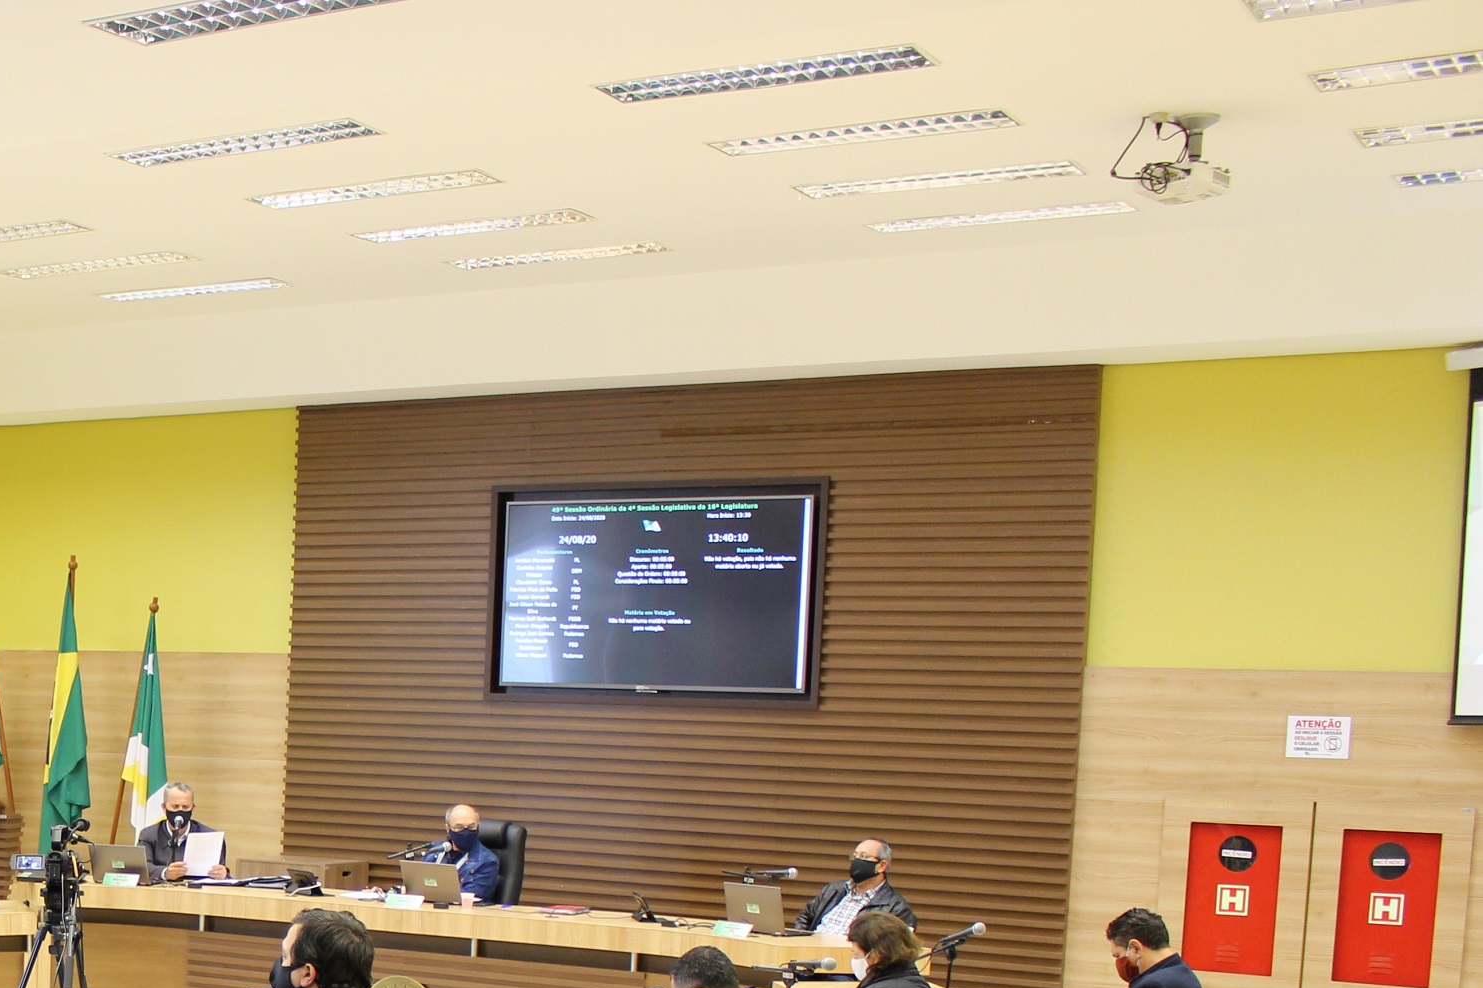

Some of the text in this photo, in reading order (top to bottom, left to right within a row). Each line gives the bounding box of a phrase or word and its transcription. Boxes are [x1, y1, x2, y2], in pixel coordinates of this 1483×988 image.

[558, 535, 596, 545] 24/08/20
[708, 533, 749, 542] 13:40:10
[1295, 719, 1342, 730] ATENÇÃO
[1221, 889, 1244, 911] H
[1374, 898, 1399, 920] H
